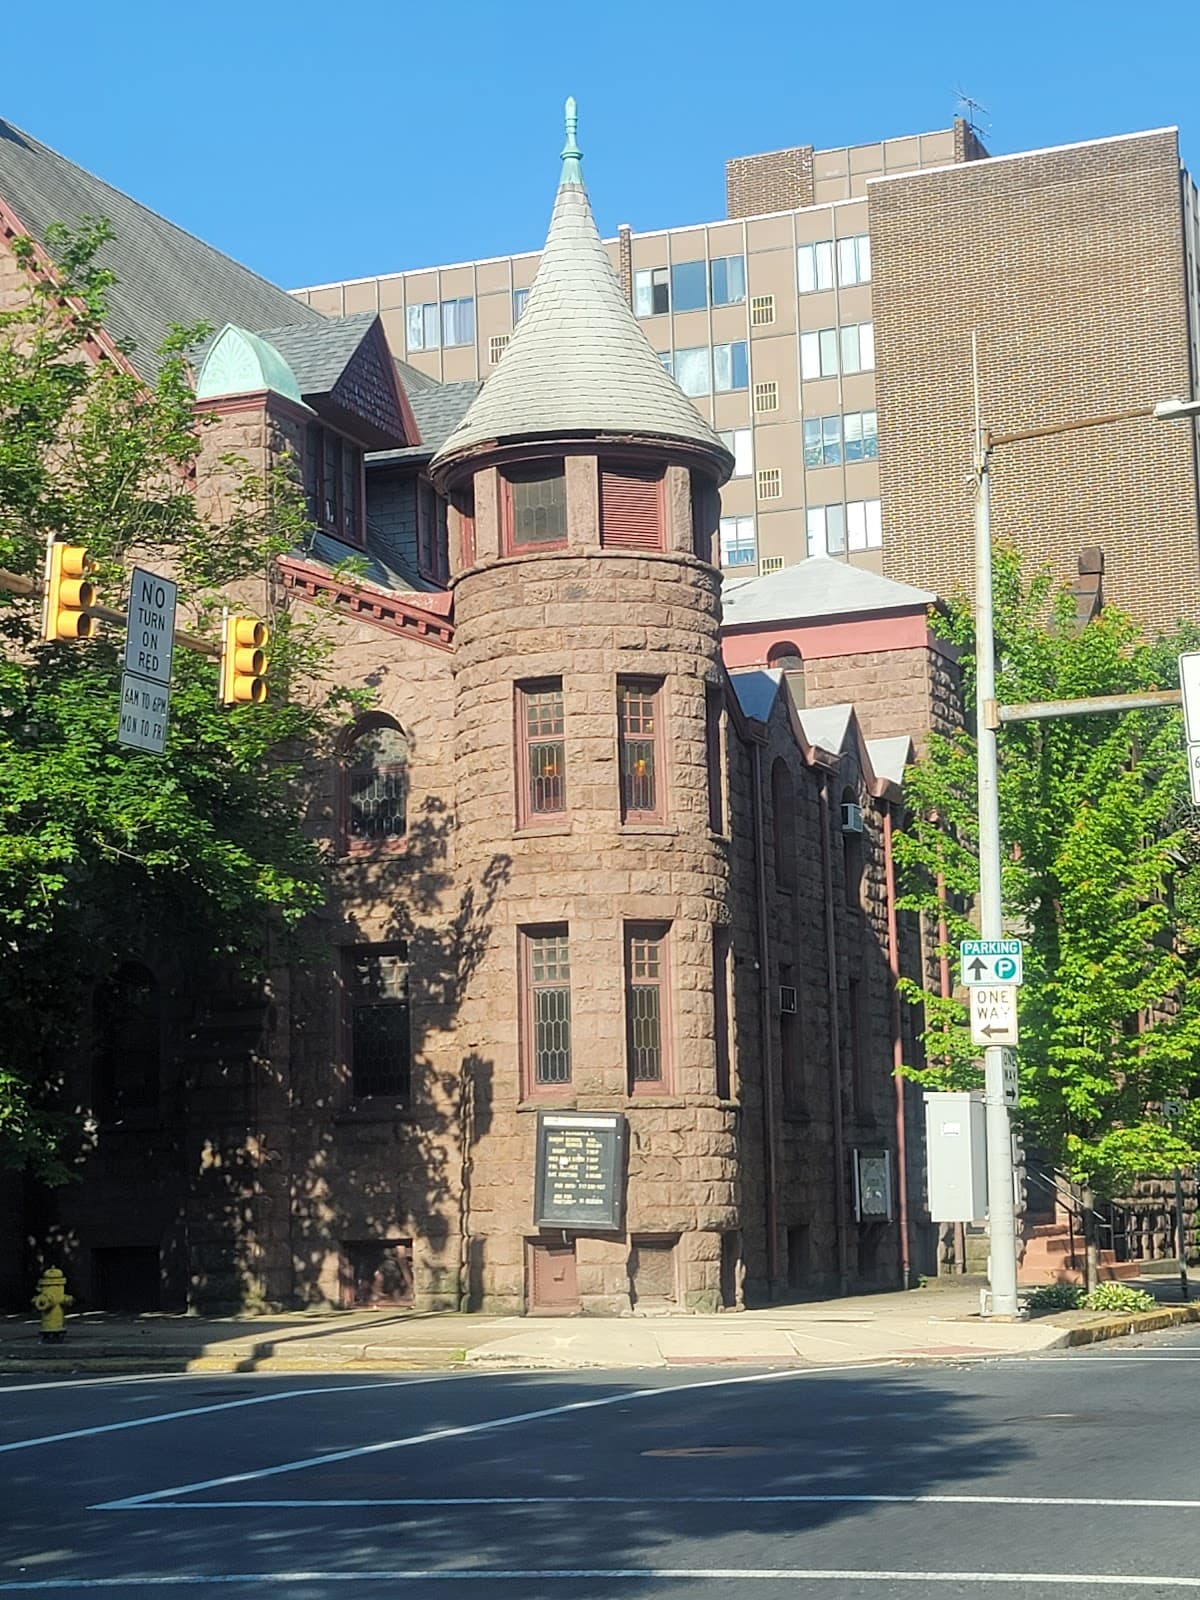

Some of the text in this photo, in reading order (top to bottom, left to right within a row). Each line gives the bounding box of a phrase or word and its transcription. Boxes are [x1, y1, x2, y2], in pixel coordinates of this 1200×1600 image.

[142, 580, 166, 609] NO
[138, 607, 166, 631] TURN
[142, 631, 159, 650] ON
[138, 651, 159, 672] RED
[124, 687, 167, 714] 6AM TO 6PM
[120, 713, 138, 733] MON
[140, 719, 150, 737] TO
[964, 942, 1019, 955] PARKING
[977, 990, 1009, 1004] ONE
[977, 1006, 1010, 1020] WAY
